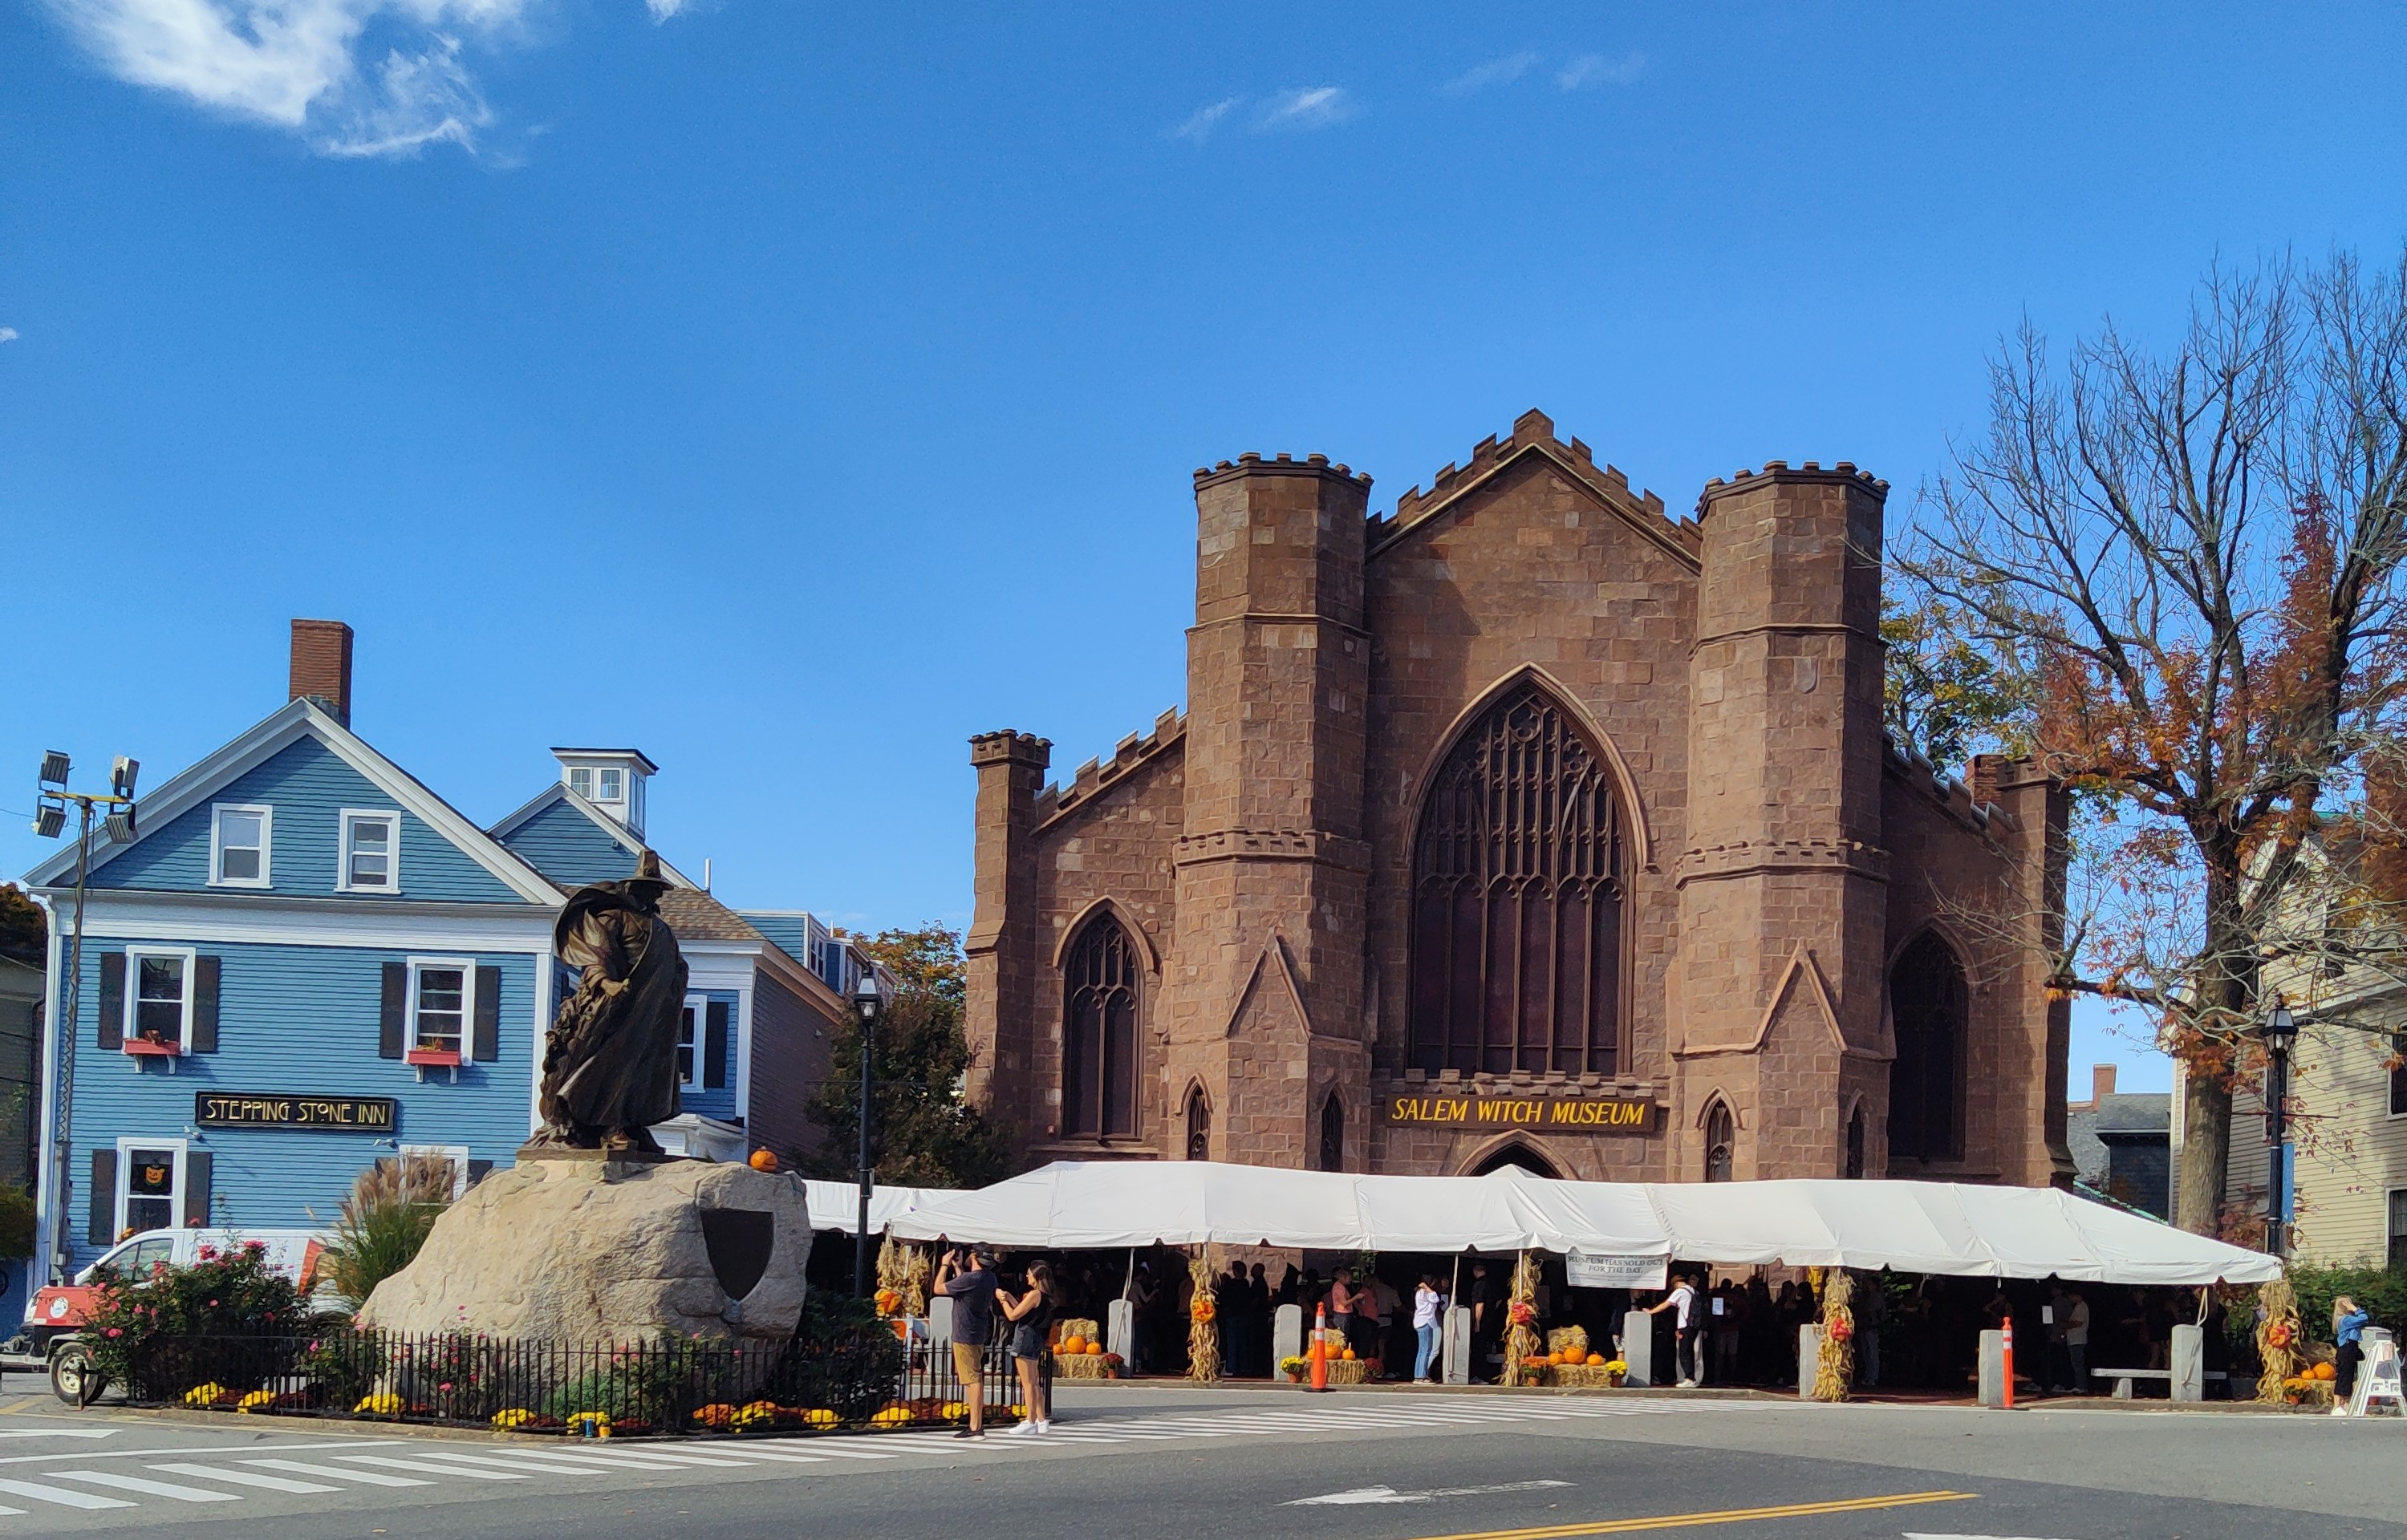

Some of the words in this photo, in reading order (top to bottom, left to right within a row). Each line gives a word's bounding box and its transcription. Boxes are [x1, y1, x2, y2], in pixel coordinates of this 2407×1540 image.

[205, 1100, 290, 1121] STEPPING
[296, 1102, 352, 1123] STONE
[358, 1104, 386, 1124] INN
[1391, 1098, 1469, 1122] SALEM
[1476, 1100, 1543, 1123] WITCH
[1550, 1101, 1646, 1125] MUSEUM
